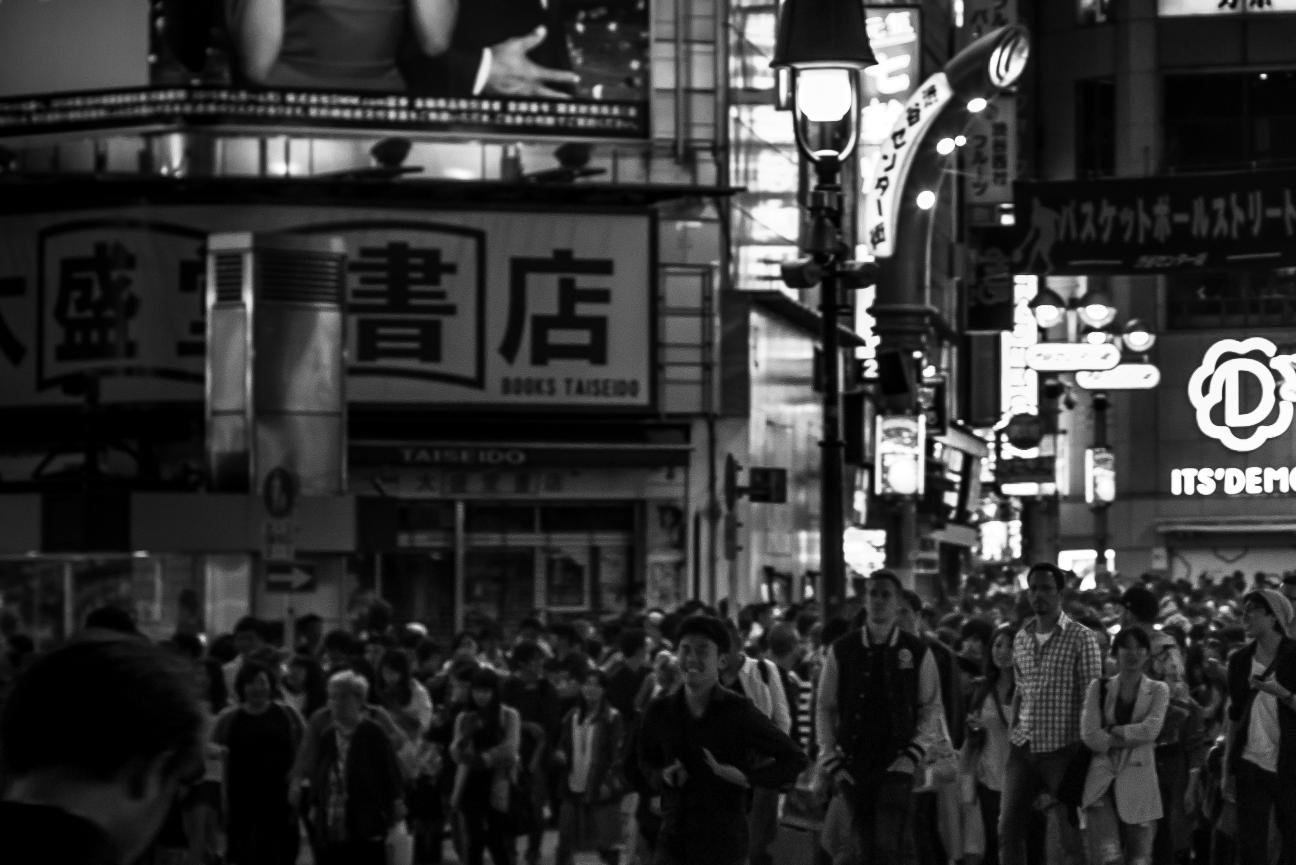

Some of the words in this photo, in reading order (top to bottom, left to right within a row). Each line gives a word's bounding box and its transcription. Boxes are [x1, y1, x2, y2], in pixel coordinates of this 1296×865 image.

[869, 84, 939, 250] 渋谷センター街
[501, 377, 557, 396] BOOKS
[564, 378, 640, 397] TAISEIDO
[402, 449, 527, 463] TAISEIDO
